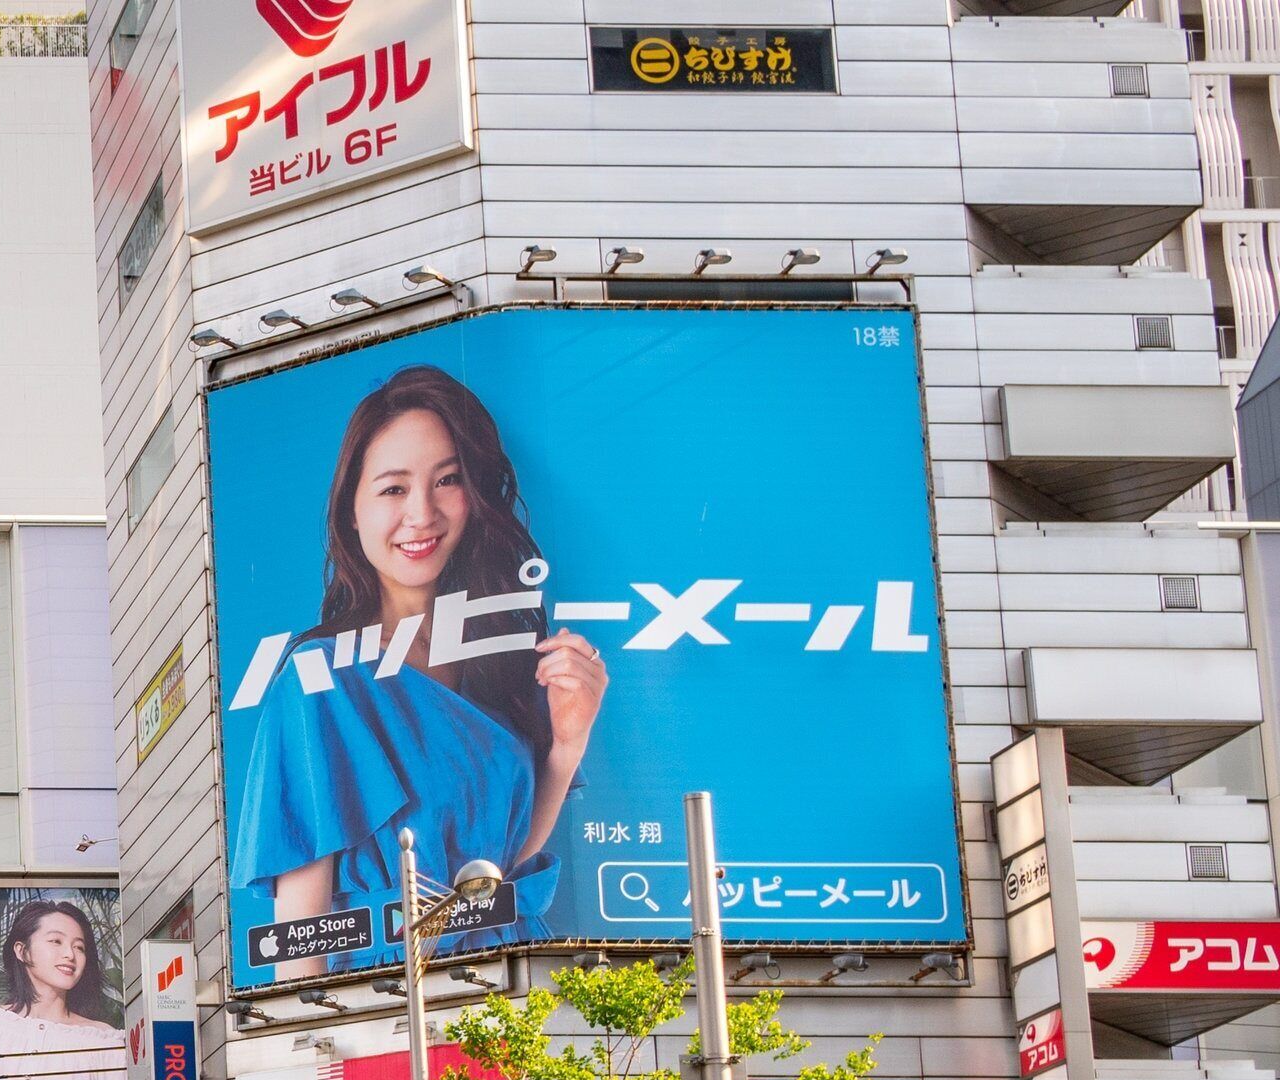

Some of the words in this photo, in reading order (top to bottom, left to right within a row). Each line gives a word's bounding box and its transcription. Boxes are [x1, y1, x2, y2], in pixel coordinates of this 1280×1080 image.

[684, 45, 792, 71] ちびすけ
[208, 40, 432, 164] アイフル
[249, 148, 331, 197] 当ビル
[344, 123, 398, 165] 6F
[852, 325, 902, 349] 18禁
[228, 558, 930, 712] ハッピーメール
[583, 821, 631, 844] 利水
[639, 822, 663, 844] 翔
[287, 923, 317, 941] App
[319, 915, 356, 934] Store
[287, 932, 368, 957] からダウンロード
[1167, 936, 1280, 973] アコム
[1027, 1042, 1059, 1070] アコム
